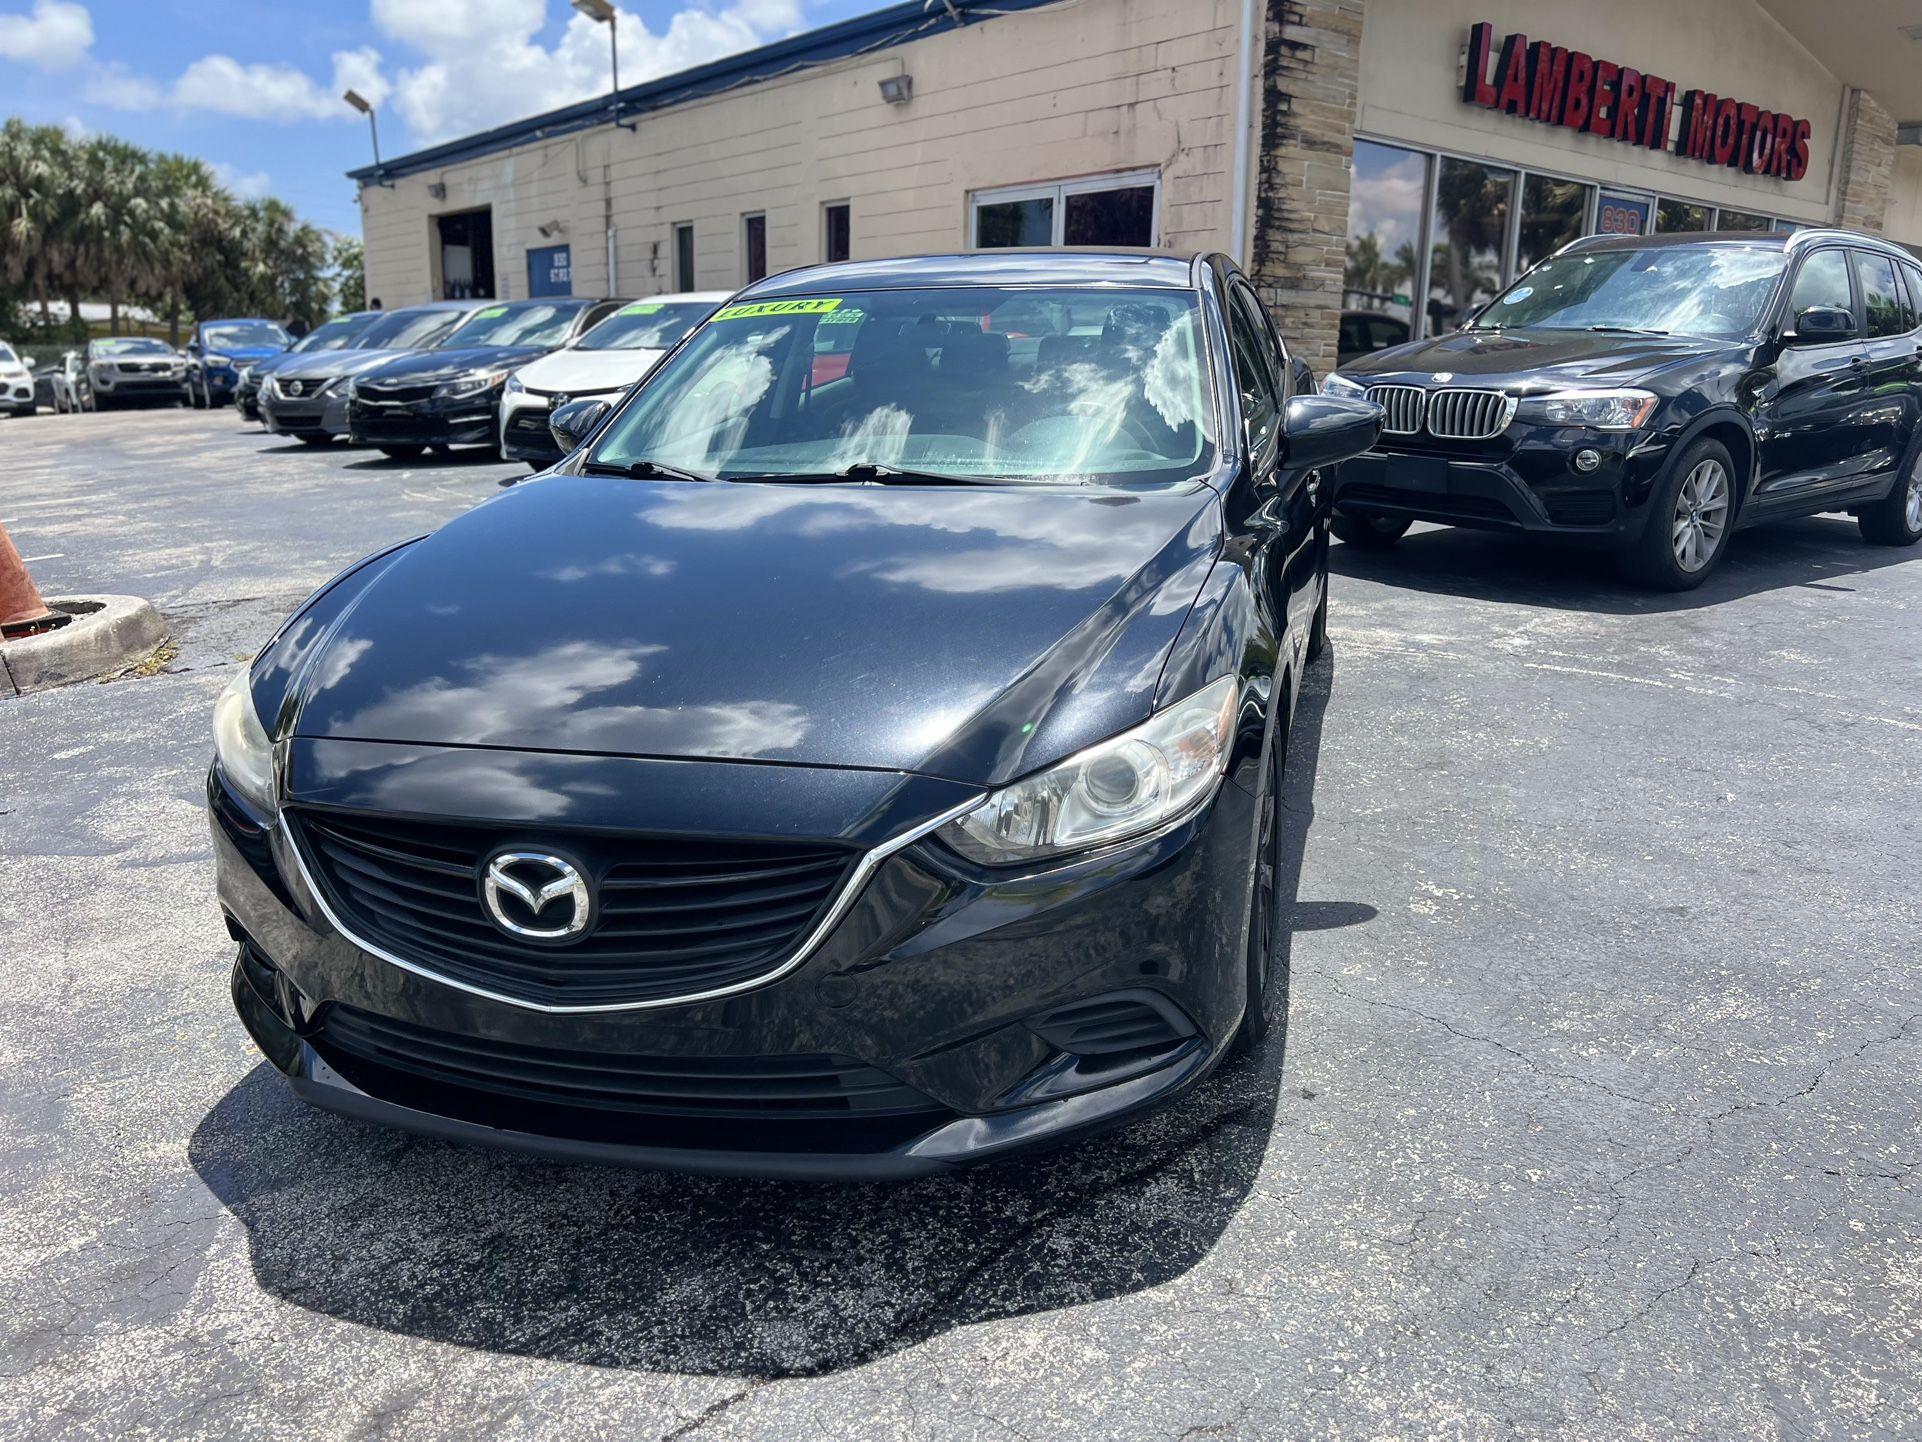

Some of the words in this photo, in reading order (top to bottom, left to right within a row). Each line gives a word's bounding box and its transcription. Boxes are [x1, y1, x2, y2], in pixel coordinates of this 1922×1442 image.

[1465, 23, 1676, 151] LAMBERTI
[1678, 90, 1811, 181] MOTORS
[1601, 205, 1640, 235] 830
[715, 300, 834, 319] LUXURY
